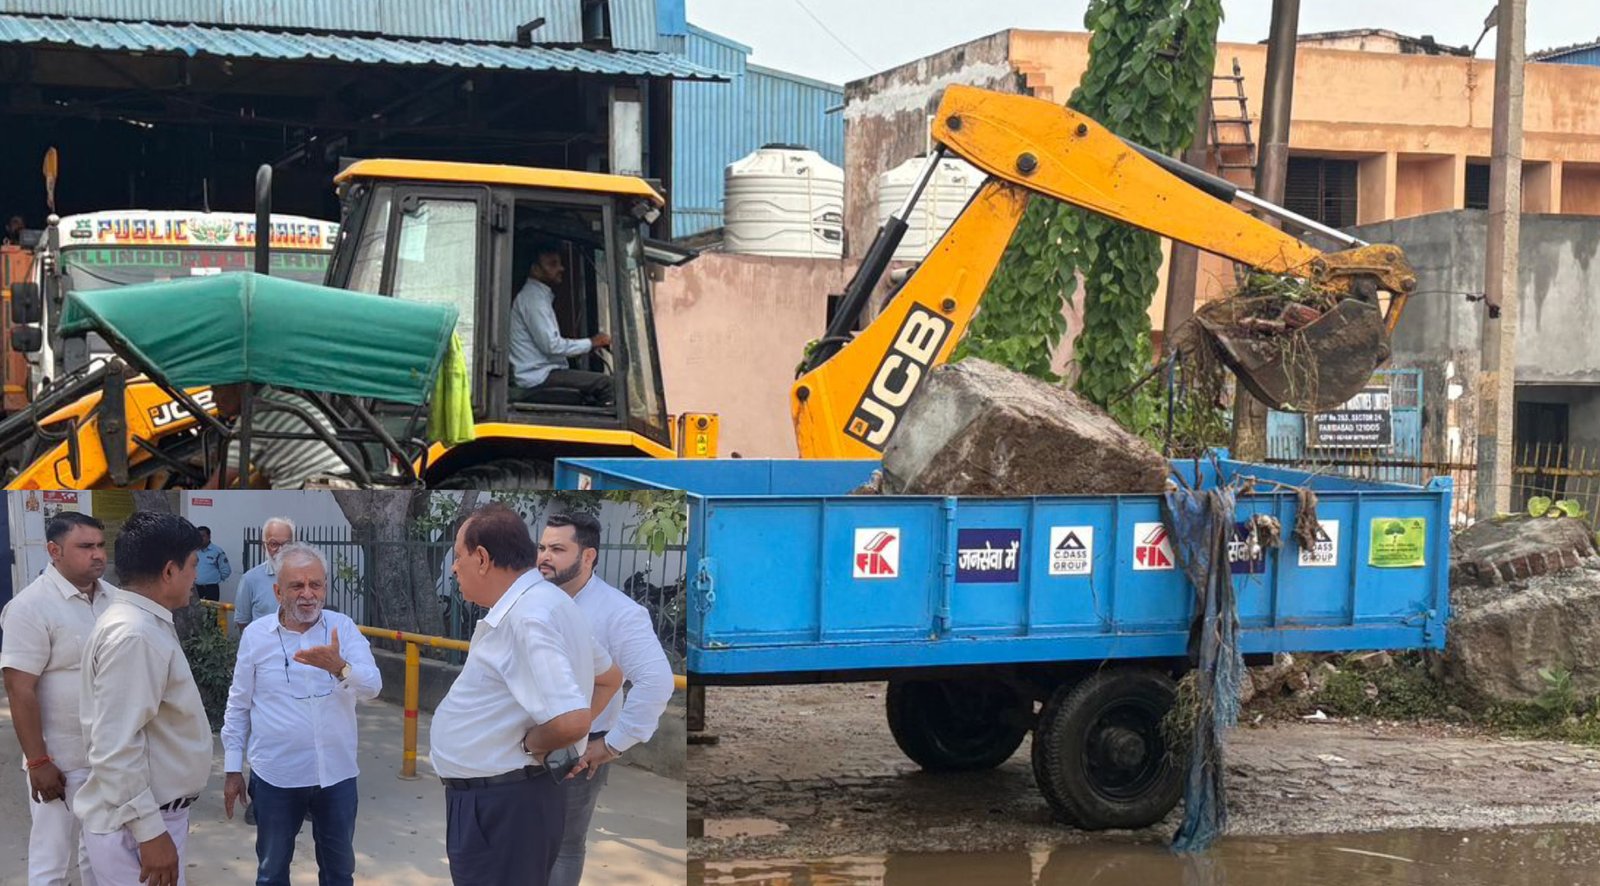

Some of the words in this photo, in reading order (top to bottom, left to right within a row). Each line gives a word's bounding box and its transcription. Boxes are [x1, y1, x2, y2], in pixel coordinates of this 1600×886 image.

[97, 219, 187, 240] PUBLIC
[234, 222, 321, 244] CARIER
[111, 250, 180, 265] INDIA
[861, 310, 946, 445] JCB
[1351, 413, 1374, 423] SECTOR
[1319, 424, 1355, 432] FARIDABAD
[856, 553, 895, 574] FIA
[958, 541, 1003, 571] जनसेवा
[1003, 540, 1019, 571] में
[1053, 550, 1087, 559] C.DASS
[1135, 546, 1172, 567] FIA
[1053, 561, 1087, 570] GROUP
